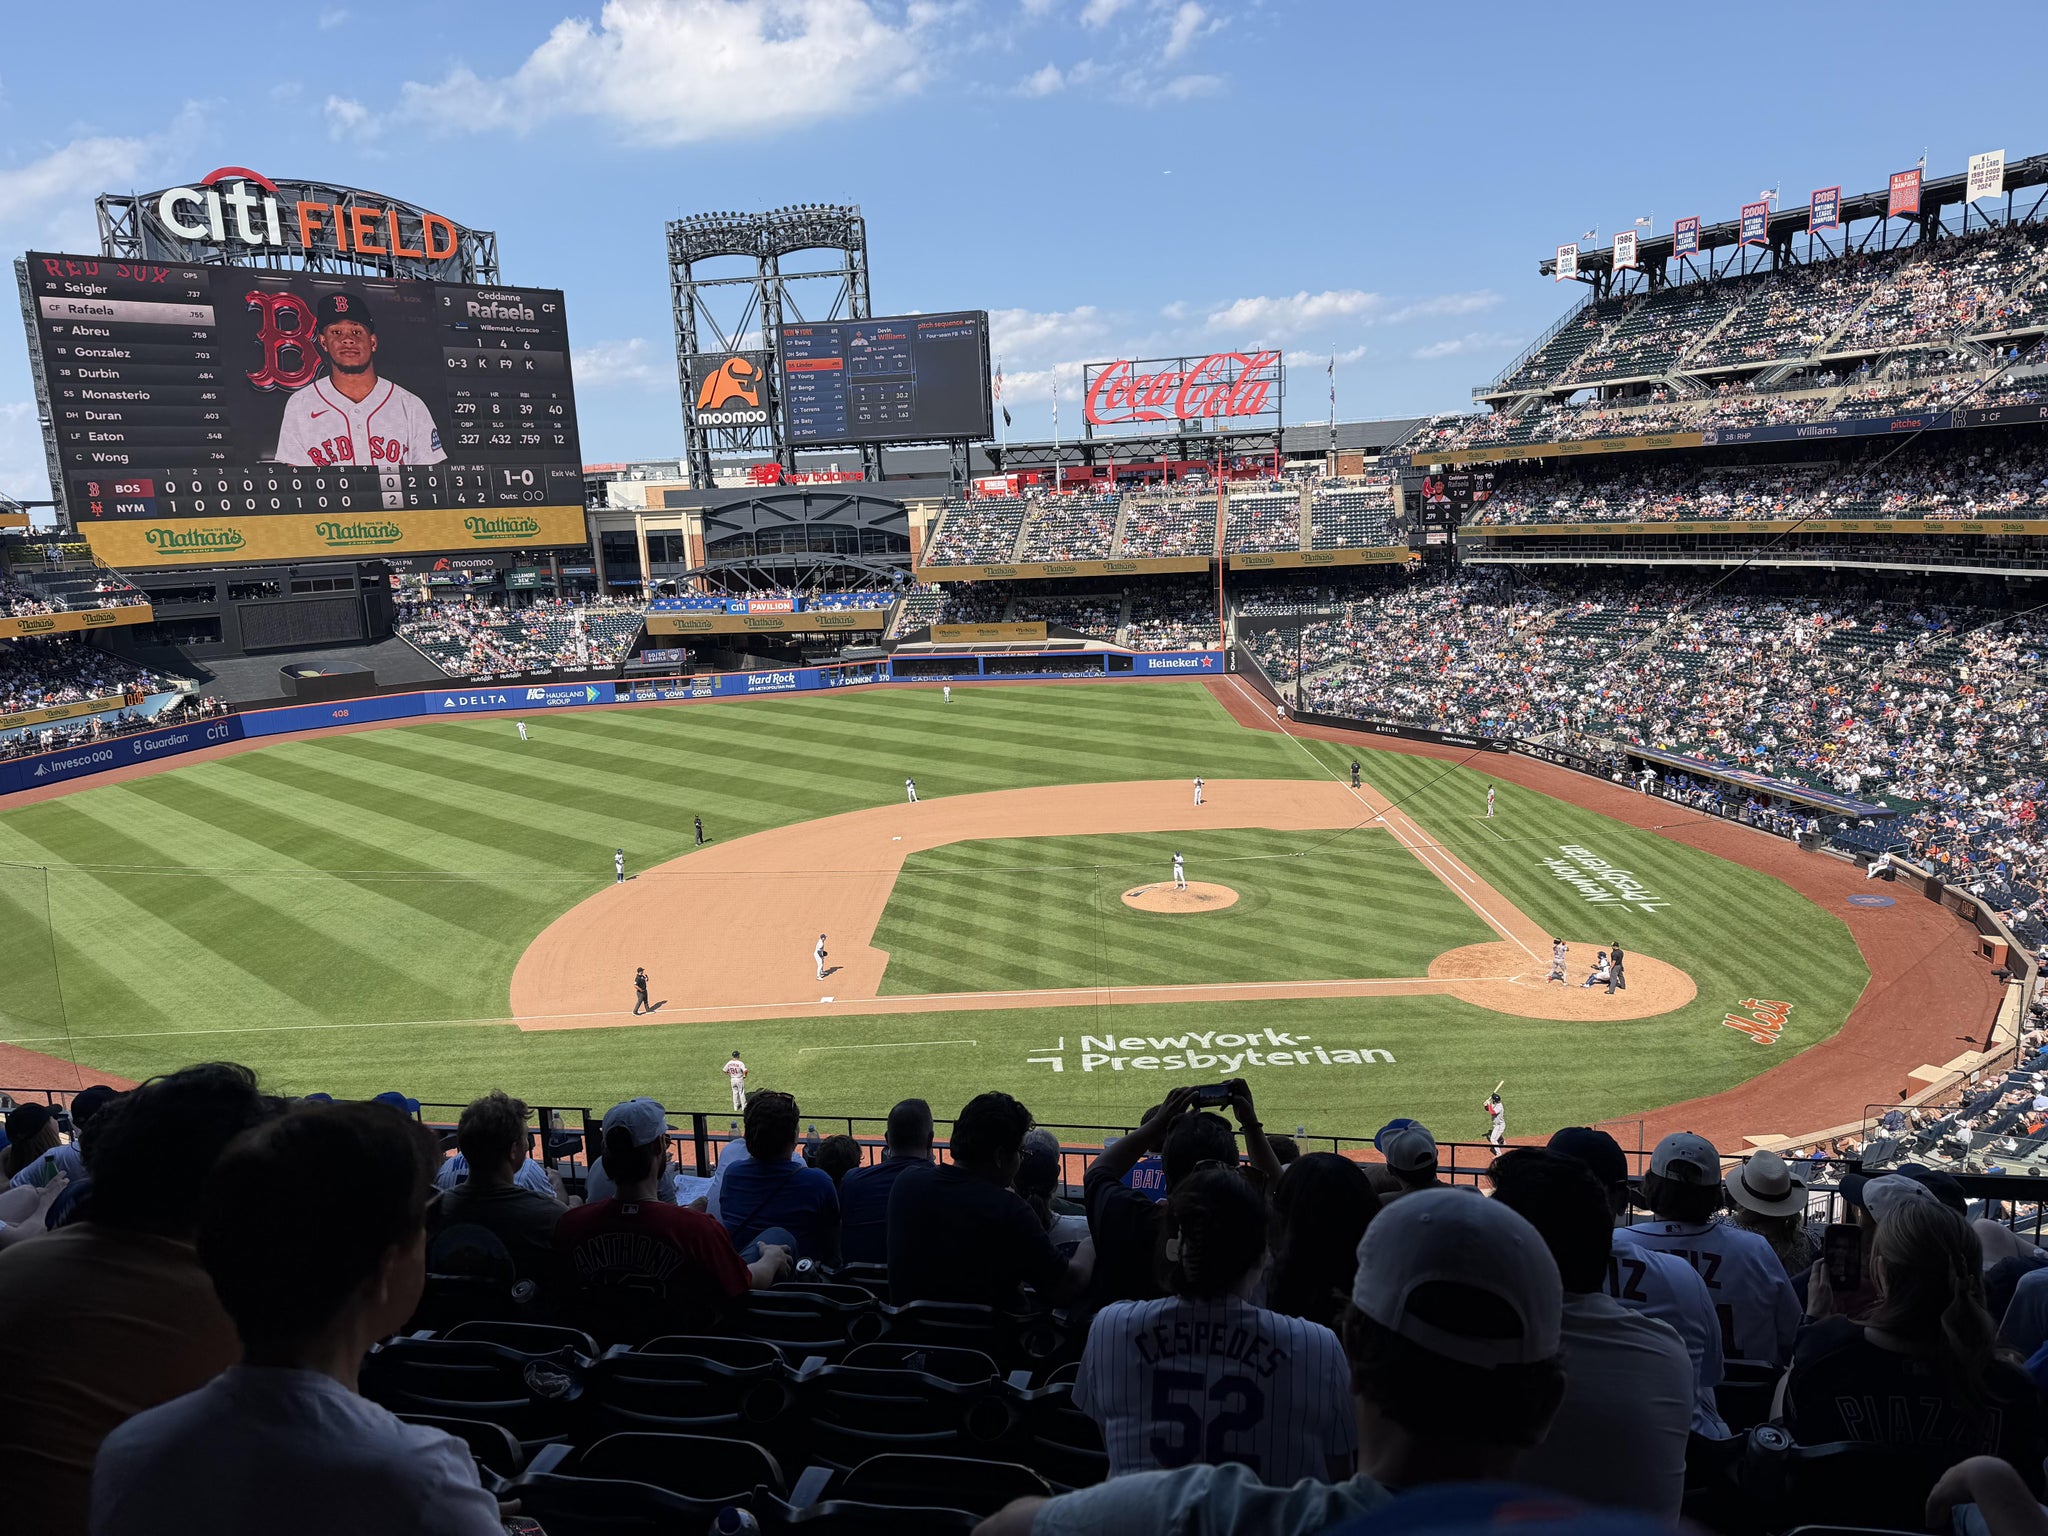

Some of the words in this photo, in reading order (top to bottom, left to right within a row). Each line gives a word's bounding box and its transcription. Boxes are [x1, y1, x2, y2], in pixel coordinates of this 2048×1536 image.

[1986, 160, 1999, 168] CARD
[1815, 191, 1835, 203] 2015
[1744, 205, 1764, 217] 2000
[159, 181, 282, 246] citi
[296, 200, 458, 259] FIELD
[1617, 234, 1632, 244] 1986
[1560, 247, 1574, 256] 1969
[64, 282, 107, 295] Seigler
[443, 297, 451, 306] 3
[477, 291, 520, 302] Ceddanne
[68, 304, 114, 316] Rafaela
[467, 301, 535, 320] Rafaela
[542, 304, 556, 313] CF
[72, 326, 110, 337] Abreu
[918, 321, 933, 330] pitch
[74, 347, 131, 358] Gonzalez
[448, 359, 467, 368] 0-3
[479, 359, 487, 368] K
[500, 360, 512, 369] F9
[526, 361, 534, 370] K
[78, 368, 120, 379] Durbin
[1085, 350, 1282, 425] Coca-Cola
[82, 390, 150, 400] Monasterio
[454, 404, 476, 413] .279
[492, 404, 500, 414] 8
[520, 405, 533, 414] 39
[549, 405, 562, 415] 40
[85, 411, 122, 421] Duran
[698, 410, 767, 425] moomoo
[1990, 412, 2001, 420] CF
[1797, 426, 1838, 437] Williams
[1891, 418, 1921, 431] pitches
[88, 432, 124, 441] Eaton
[459, 434, 479, 444] .327
[489, 435, 512, 444] .432
[520, 435, 540, 444] .759
[554, 435, 564, 444] 12
[308, 436, 354, 466] RED
[92, 453, 129, 464] Wong
[115, 484, 141, 493] BOS
[386, 477, 395, 488] 0
[408, 477, 417, 487] 2
[429, 477, 437, 487] 0
[504, 469, 534, 486] 1-0
[784, 472, 811, 483] new
[812, 470, 864, 482] balance
[116, 504, 145, 513] NYM
[389, 495, 397, 505] 2
[410, 494, 418, 504] 5
[433, 494, 438, 504] 1
[316, 521, 403, 542] Nathan's
[464, 515, 541, 537] Nathan's
[145, 528, 247, 552] Nathan's
[452, 558, 494, 568] moomoo
[731, 601, 746, 611] citi
[751, 602, 790, 611] PAVILION
[18, 618, 55, 632] Nathan's
[673, 619, 713, 631] Nathan's
[744, 617, 784, 629] Nathan's
[816, 615, 856, 627] Nathan's
[1149, 657, 1197, 668] Heineken
[748, 674, 771, 685] Hard
[773, 672, 795, 684] Rock
[846, 676, 872, 685] DUNKIN'
[459, 695, 506, 706] DELTA
[615, 694, 630, 702] 380
[332, 709, 349, 718] 408
[207, 723, 228, 740] citi
[144, 733, 188, 751] Guardian
[51, 755, 92, 772] Invesco
[92, 749, 113, 762] QQQ
[1722, 998, 1793, 1045] Mets
[1081, 1028, 1311, 1052] NewYork-
[1082, 1046, 1396, 1073] Presbyterian
[1132, 1169, 1167, 1190] BAT
[1134, 1322, 1286, 1378] CESPEDES
[1151, 1370, 1264, 1472] 52
